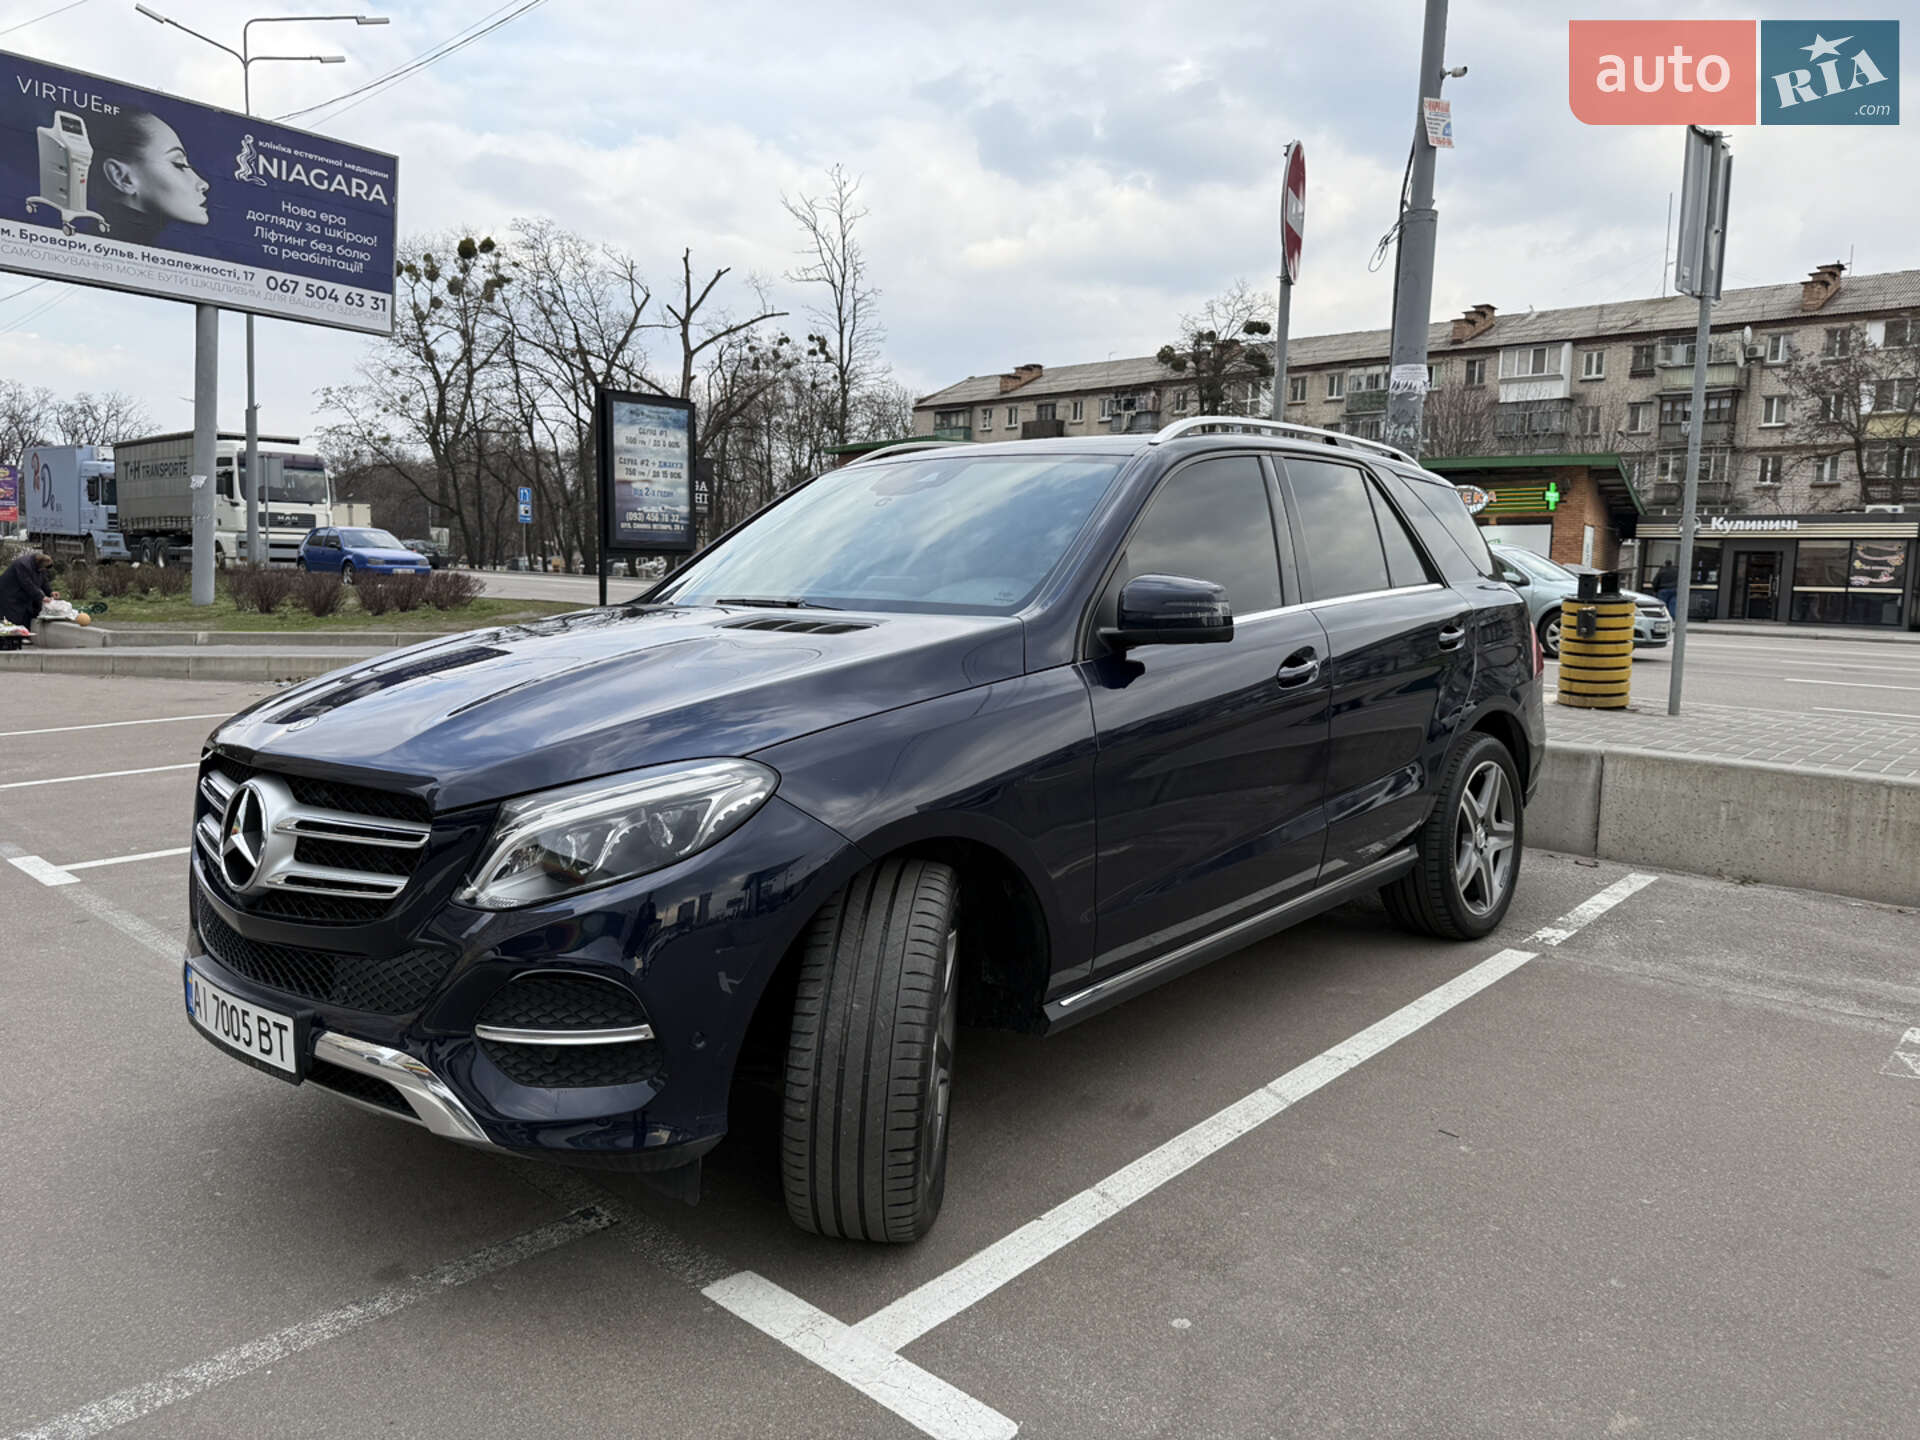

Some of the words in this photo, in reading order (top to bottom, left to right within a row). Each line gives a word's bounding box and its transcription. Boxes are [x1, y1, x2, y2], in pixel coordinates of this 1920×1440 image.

[258, 140, 292, 154] клініка
[293, 149, 343, 168] естетичної
[344, 162, 389, 179] медицини
[258, 154, 388, 206] NIAGARA
[246, 209, 302, 231] догляду
[305, 222, 321, 234] за
[324, 226, 378, 248] шкірою!
[281, 200, 317, 219] Нова
[320, 211, 347, 226] ера
[0, 227, 15, 238] м.
[20, 228, 91, 253] Бровари,
[94, 242, 138, 260] бульв.
[141, 251, 240, 281] Незалежності,
[243, 270, 256, 281] 17
[254, 226, 307, 247] Ліфтинг
[310, 239, 333, 254] без
[336, 244, 371, 261] болю
[262, 244, 278, 255] та
[281, 248, 364, 273] реабілітації!
[266, 275, 299, 295] 067
[305, 283, 339, 303] 504
[344, 291, 365, 308] 63
[370, 296, 386, 312] 31
[277, 514, 299, 522] MAN
[194, 980, 208, 1022] AI
[212, 993, 252, 1047] 7005
[257, 1015, 288, 1062] BT
